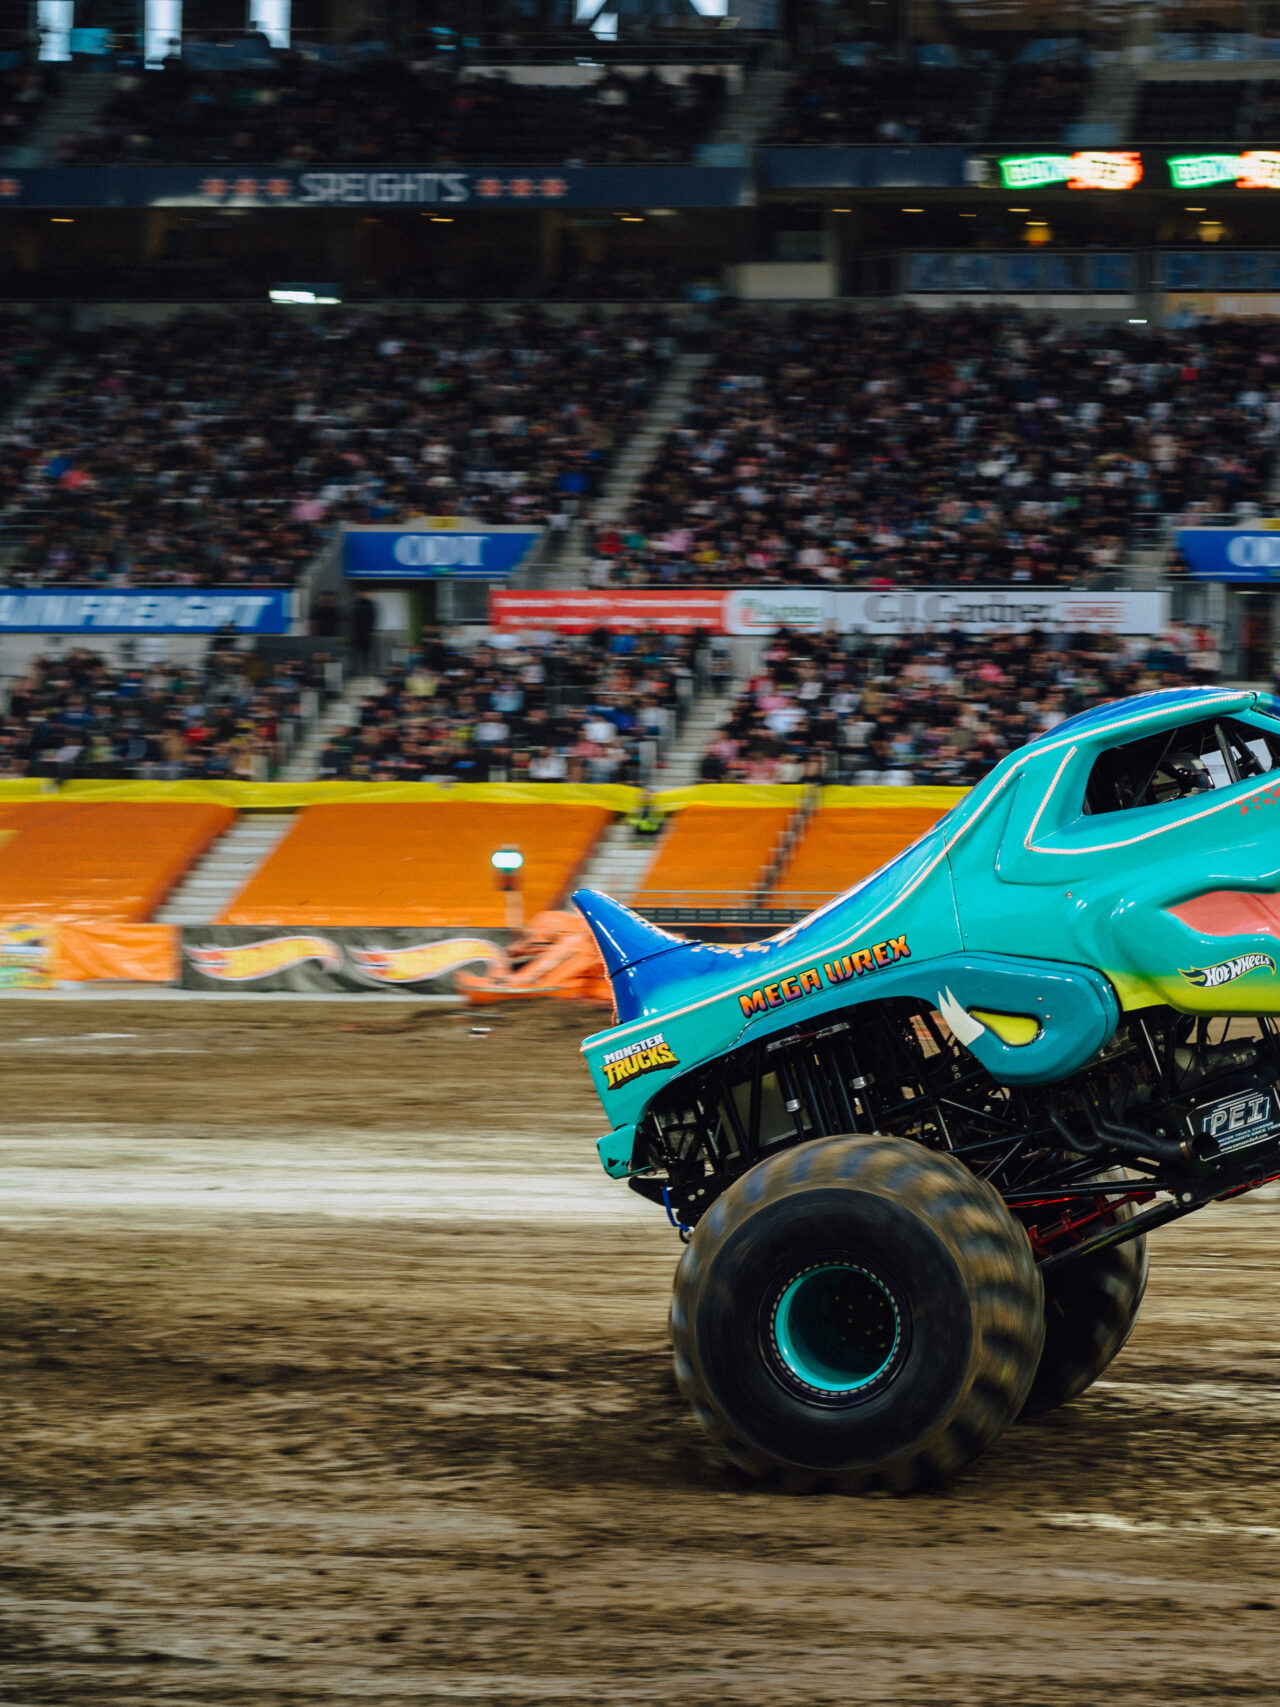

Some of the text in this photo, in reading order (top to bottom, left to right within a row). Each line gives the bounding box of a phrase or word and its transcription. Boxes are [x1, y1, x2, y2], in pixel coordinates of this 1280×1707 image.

[738, 934, 911, 1018] MEGA WREX
[1201, 964, 1230, 987] HOT
[602, 1032, 665, 1065] MONSTER
[602, 1042, 681, 1090] TRUCKS
[1210, 1097, 1264, 1136] PEI
